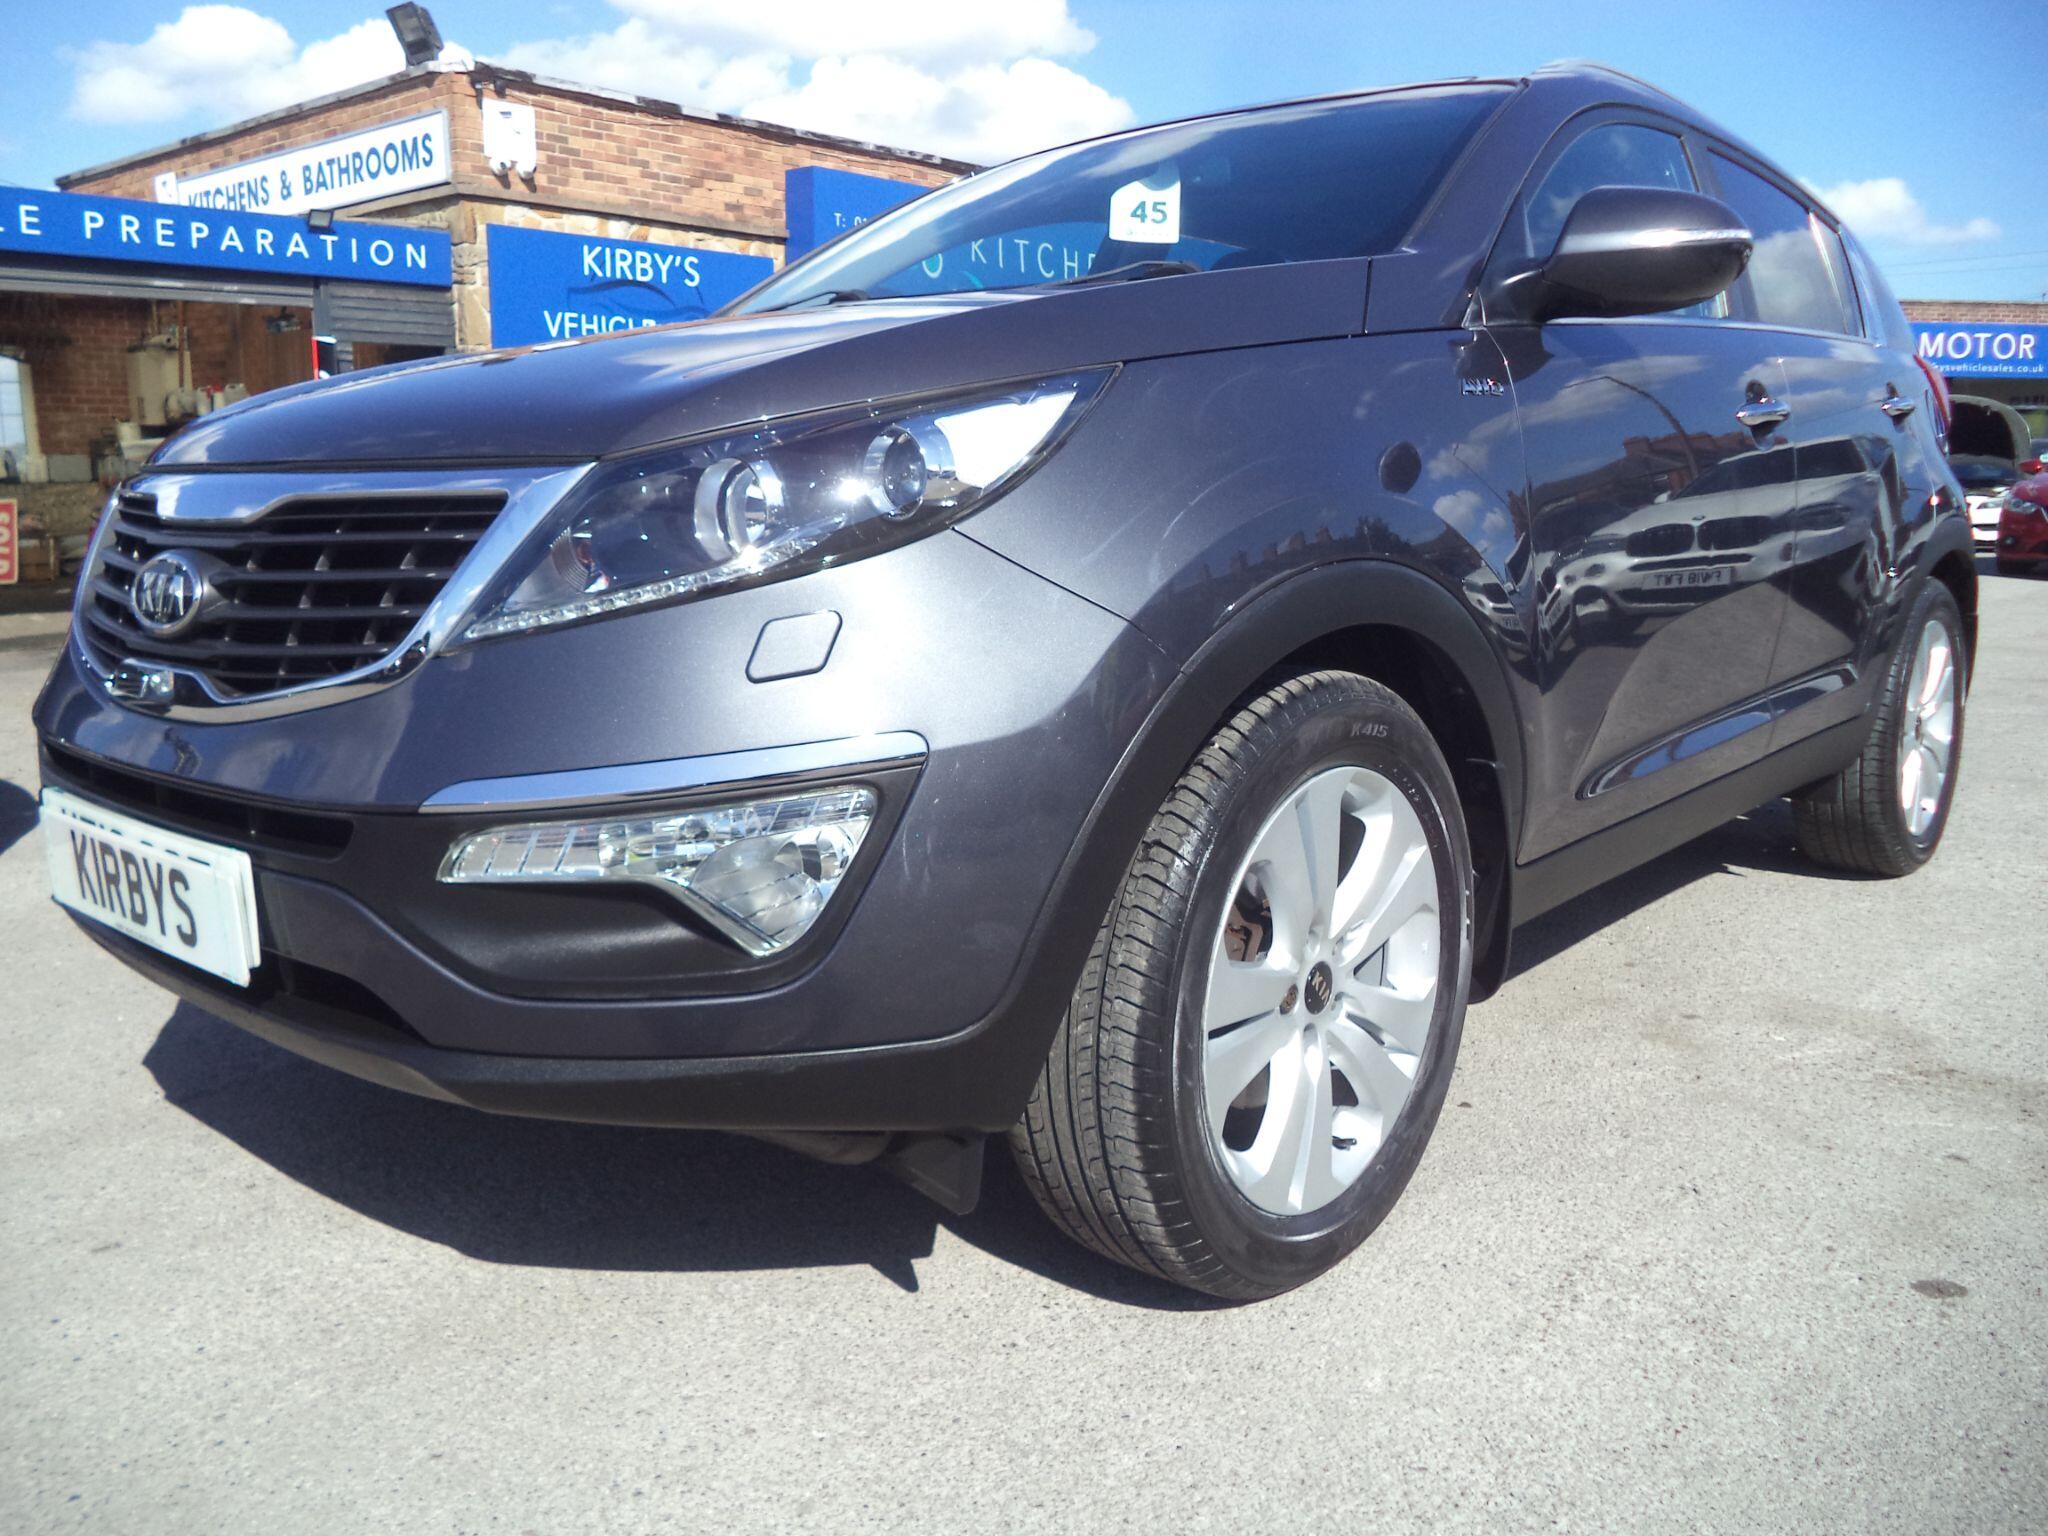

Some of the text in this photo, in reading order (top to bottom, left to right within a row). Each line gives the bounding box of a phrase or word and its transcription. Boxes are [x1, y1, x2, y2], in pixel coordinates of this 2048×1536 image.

[187, 175, 270, 212] KITCHENS
[279, 173, 293, 196] &
[302, 132, 434, 196] BATHROOMS
[1130, 201, 1168, 224] 45
[84, 210, 428, 269] PREPARATION
[583, 245, 700, 287] KIRBY'S
[1918, 332, 2036, 359] MOTOR
[70, 829, 198, 948] KIRBYS
